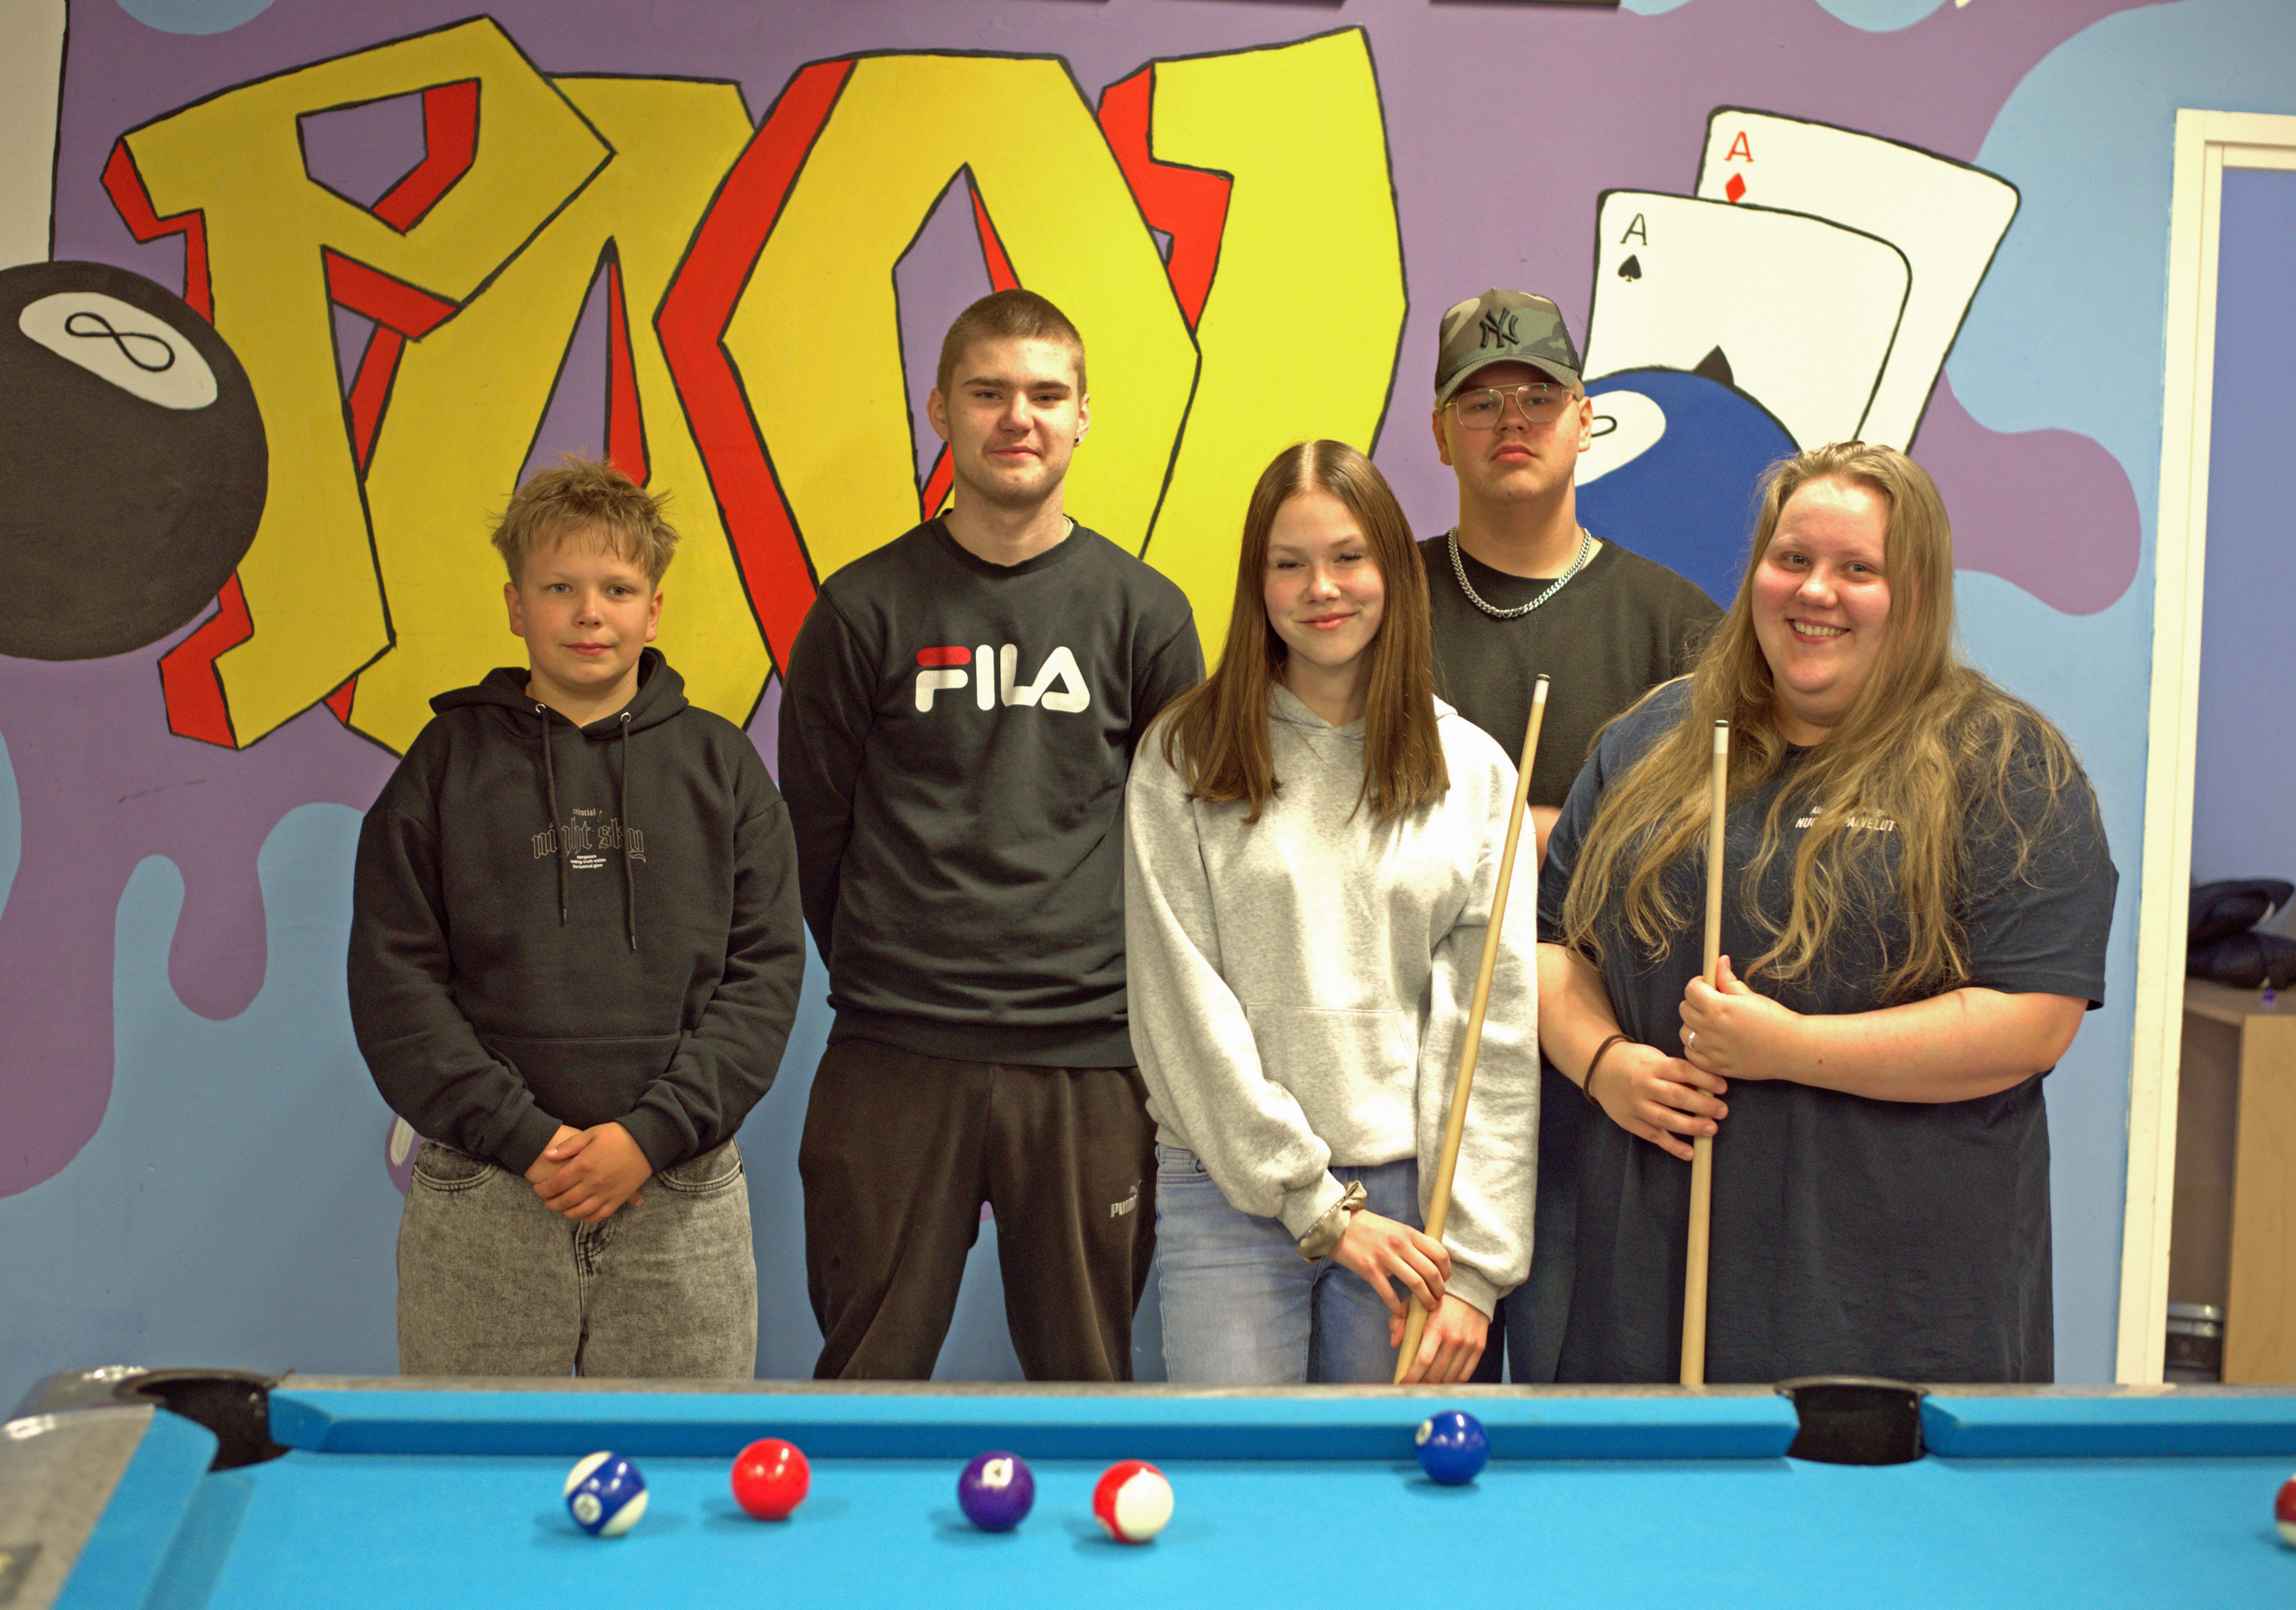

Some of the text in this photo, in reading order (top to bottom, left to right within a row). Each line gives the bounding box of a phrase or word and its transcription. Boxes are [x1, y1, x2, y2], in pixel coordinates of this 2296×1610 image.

[1724, 131, 1754, 162] A
[1620, 213, 1648, 246] A
[915, 643, 1090, 713] FILA
